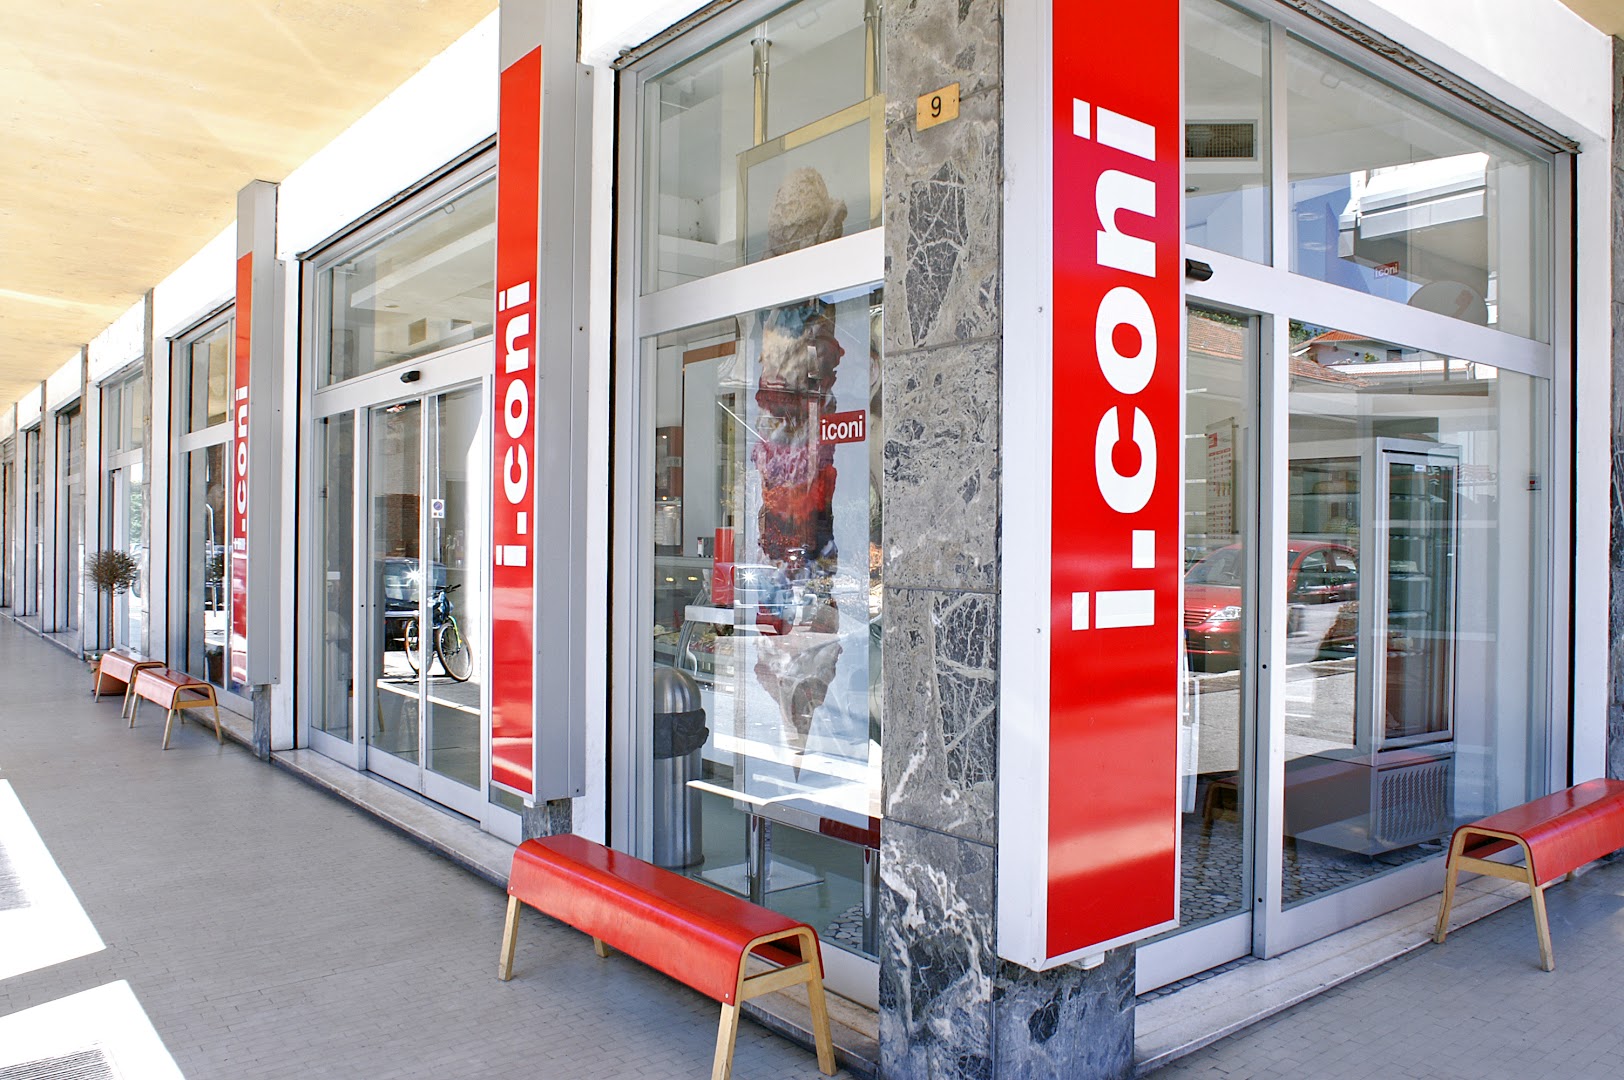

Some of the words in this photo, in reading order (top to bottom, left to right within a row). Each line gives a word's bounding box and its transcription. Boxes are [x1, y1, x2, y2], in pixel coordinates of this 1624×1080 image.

[931, 95, 942, 118] 9
[495, 281, 530, 567] i.coni
[1072, 97, 1157, 631] i.coni
